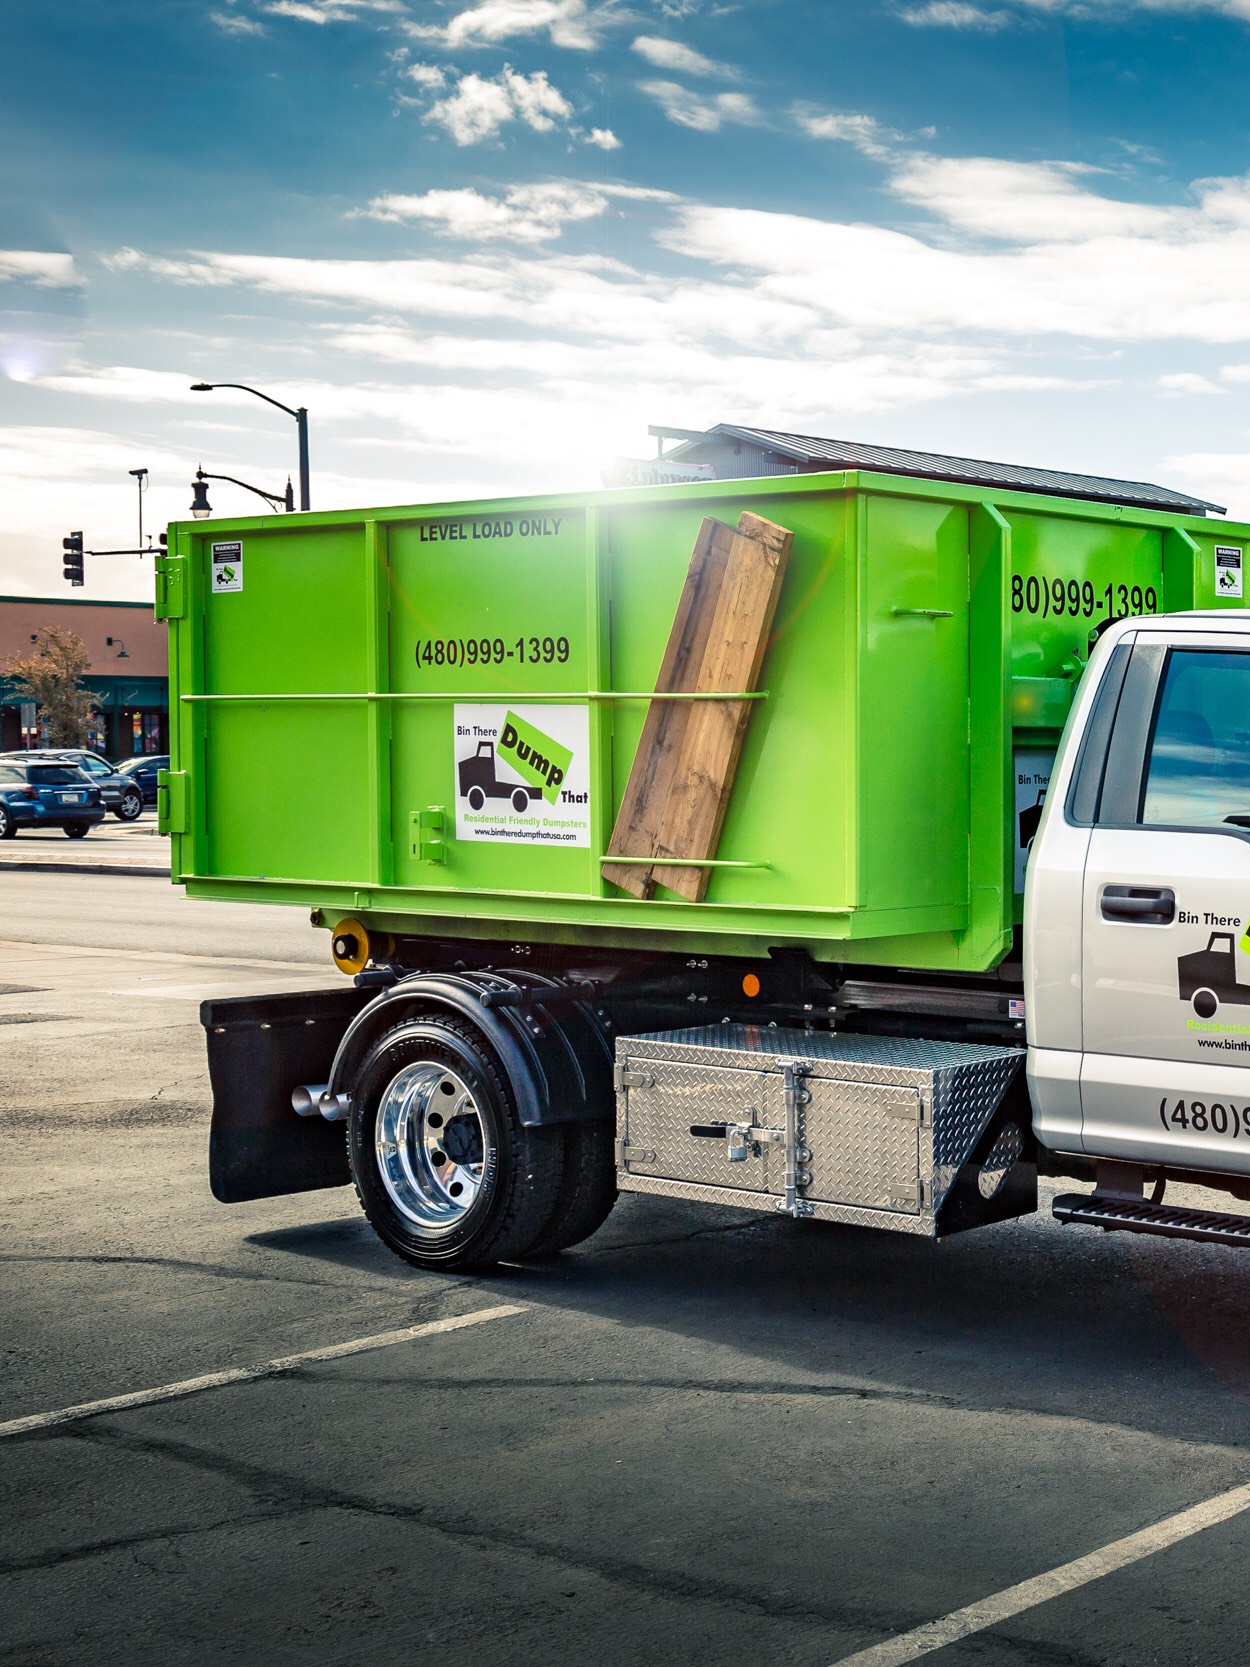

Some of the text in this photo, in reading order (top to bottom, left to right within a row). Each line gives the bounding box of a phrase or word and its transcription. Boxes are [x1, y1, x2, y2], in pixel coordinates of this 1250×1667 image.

[419, 518, 562, 542] LEVEL LOAD ONLY
[214, 544, 240, 552] WARNING
[415, 636, 570, 669] (480)999-1399
[457, 725, 498, 737] Bin There
[500, 722, 564, 788] Dump
[1018, 774, 1032, 785] Bin
[561, 790, 589, 804] That
[463, 813, 588, 829] Residential Friendly Dumpsters
[474, 828, 577, 841] www.bintheredumpthatusa.com
[1178, 911, 1241, 927] Bin There
